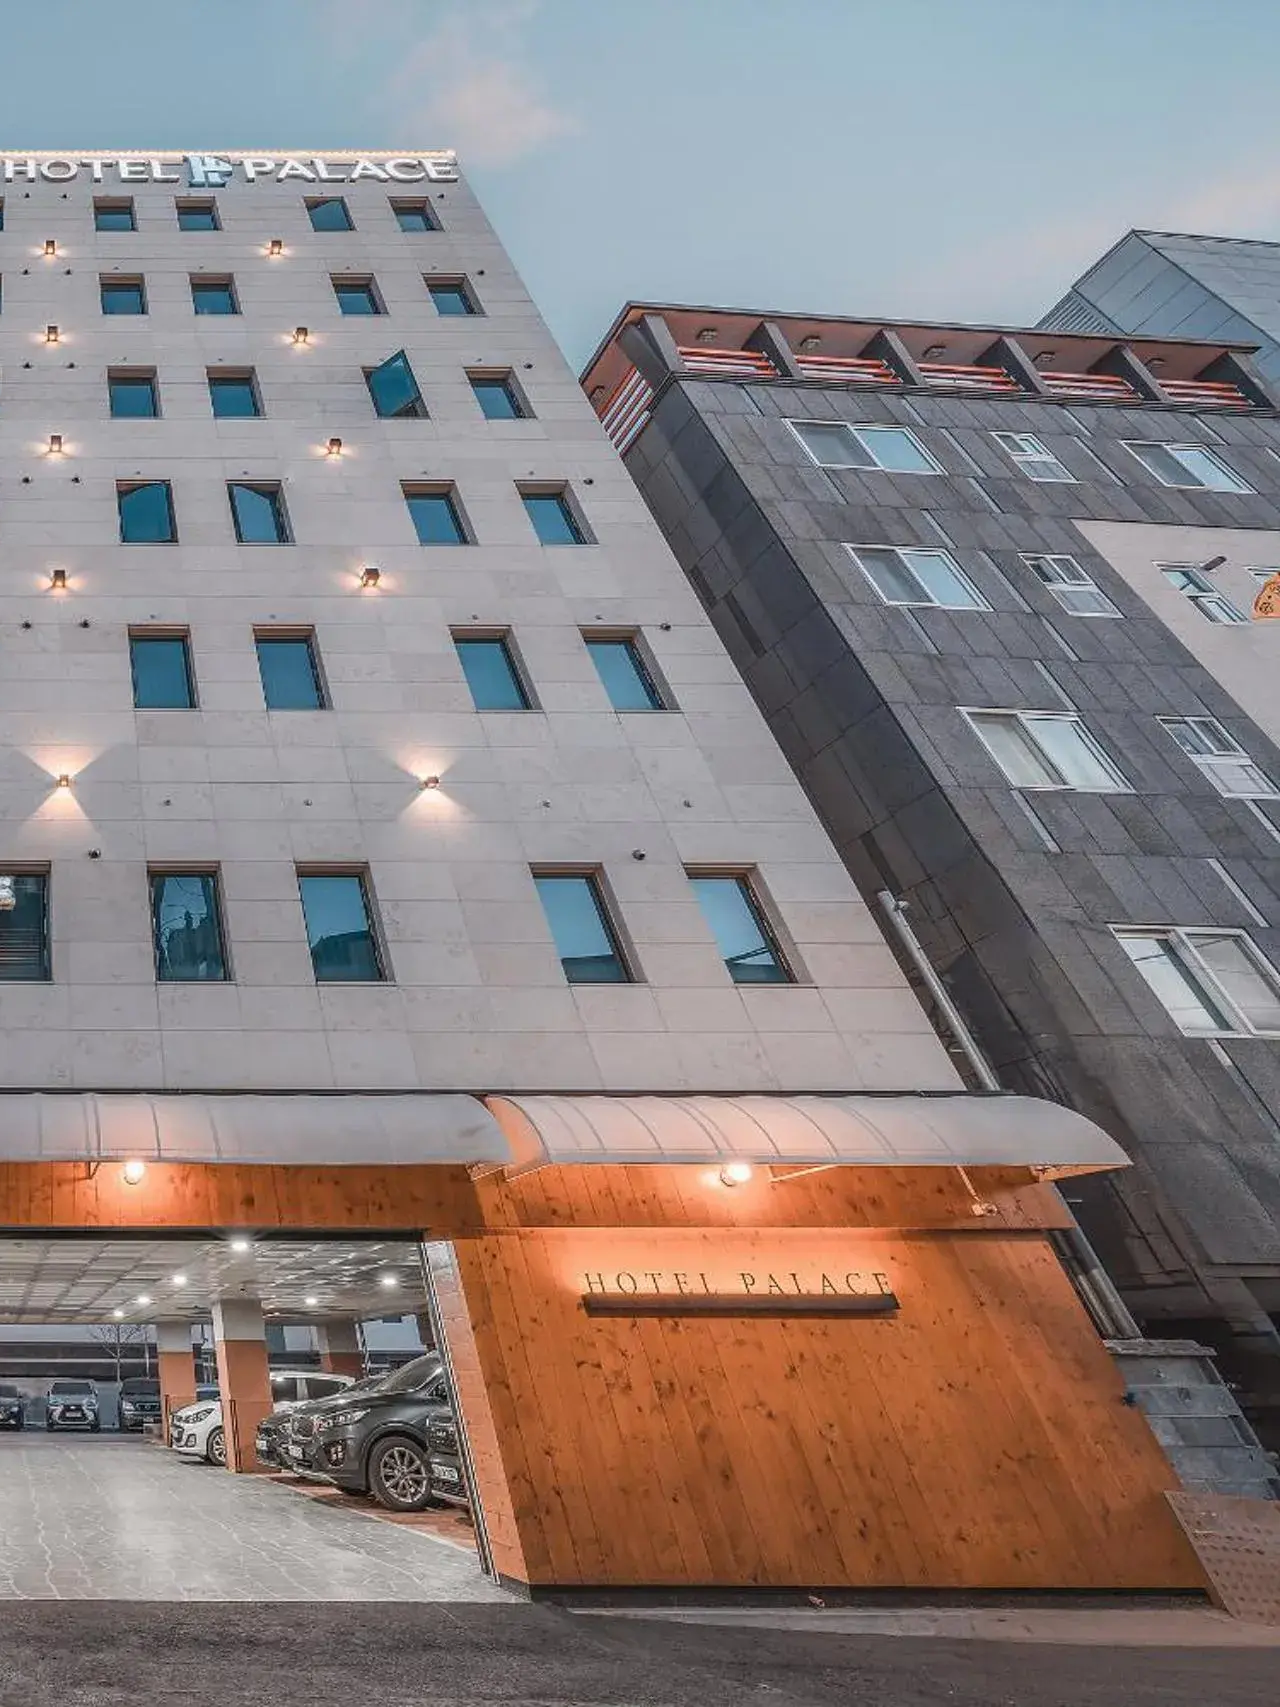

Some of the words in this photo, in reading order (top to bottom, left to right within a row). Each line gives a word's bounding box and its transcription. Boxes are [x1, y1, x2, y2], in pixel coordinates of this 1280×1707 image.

[3, 158, 180, 183] HOTEL
[241, 158, 459, 183] PALACE
[584, 1272, 718, 1295] HOTEL
[739, 1272, 891, 1295] PALACE
